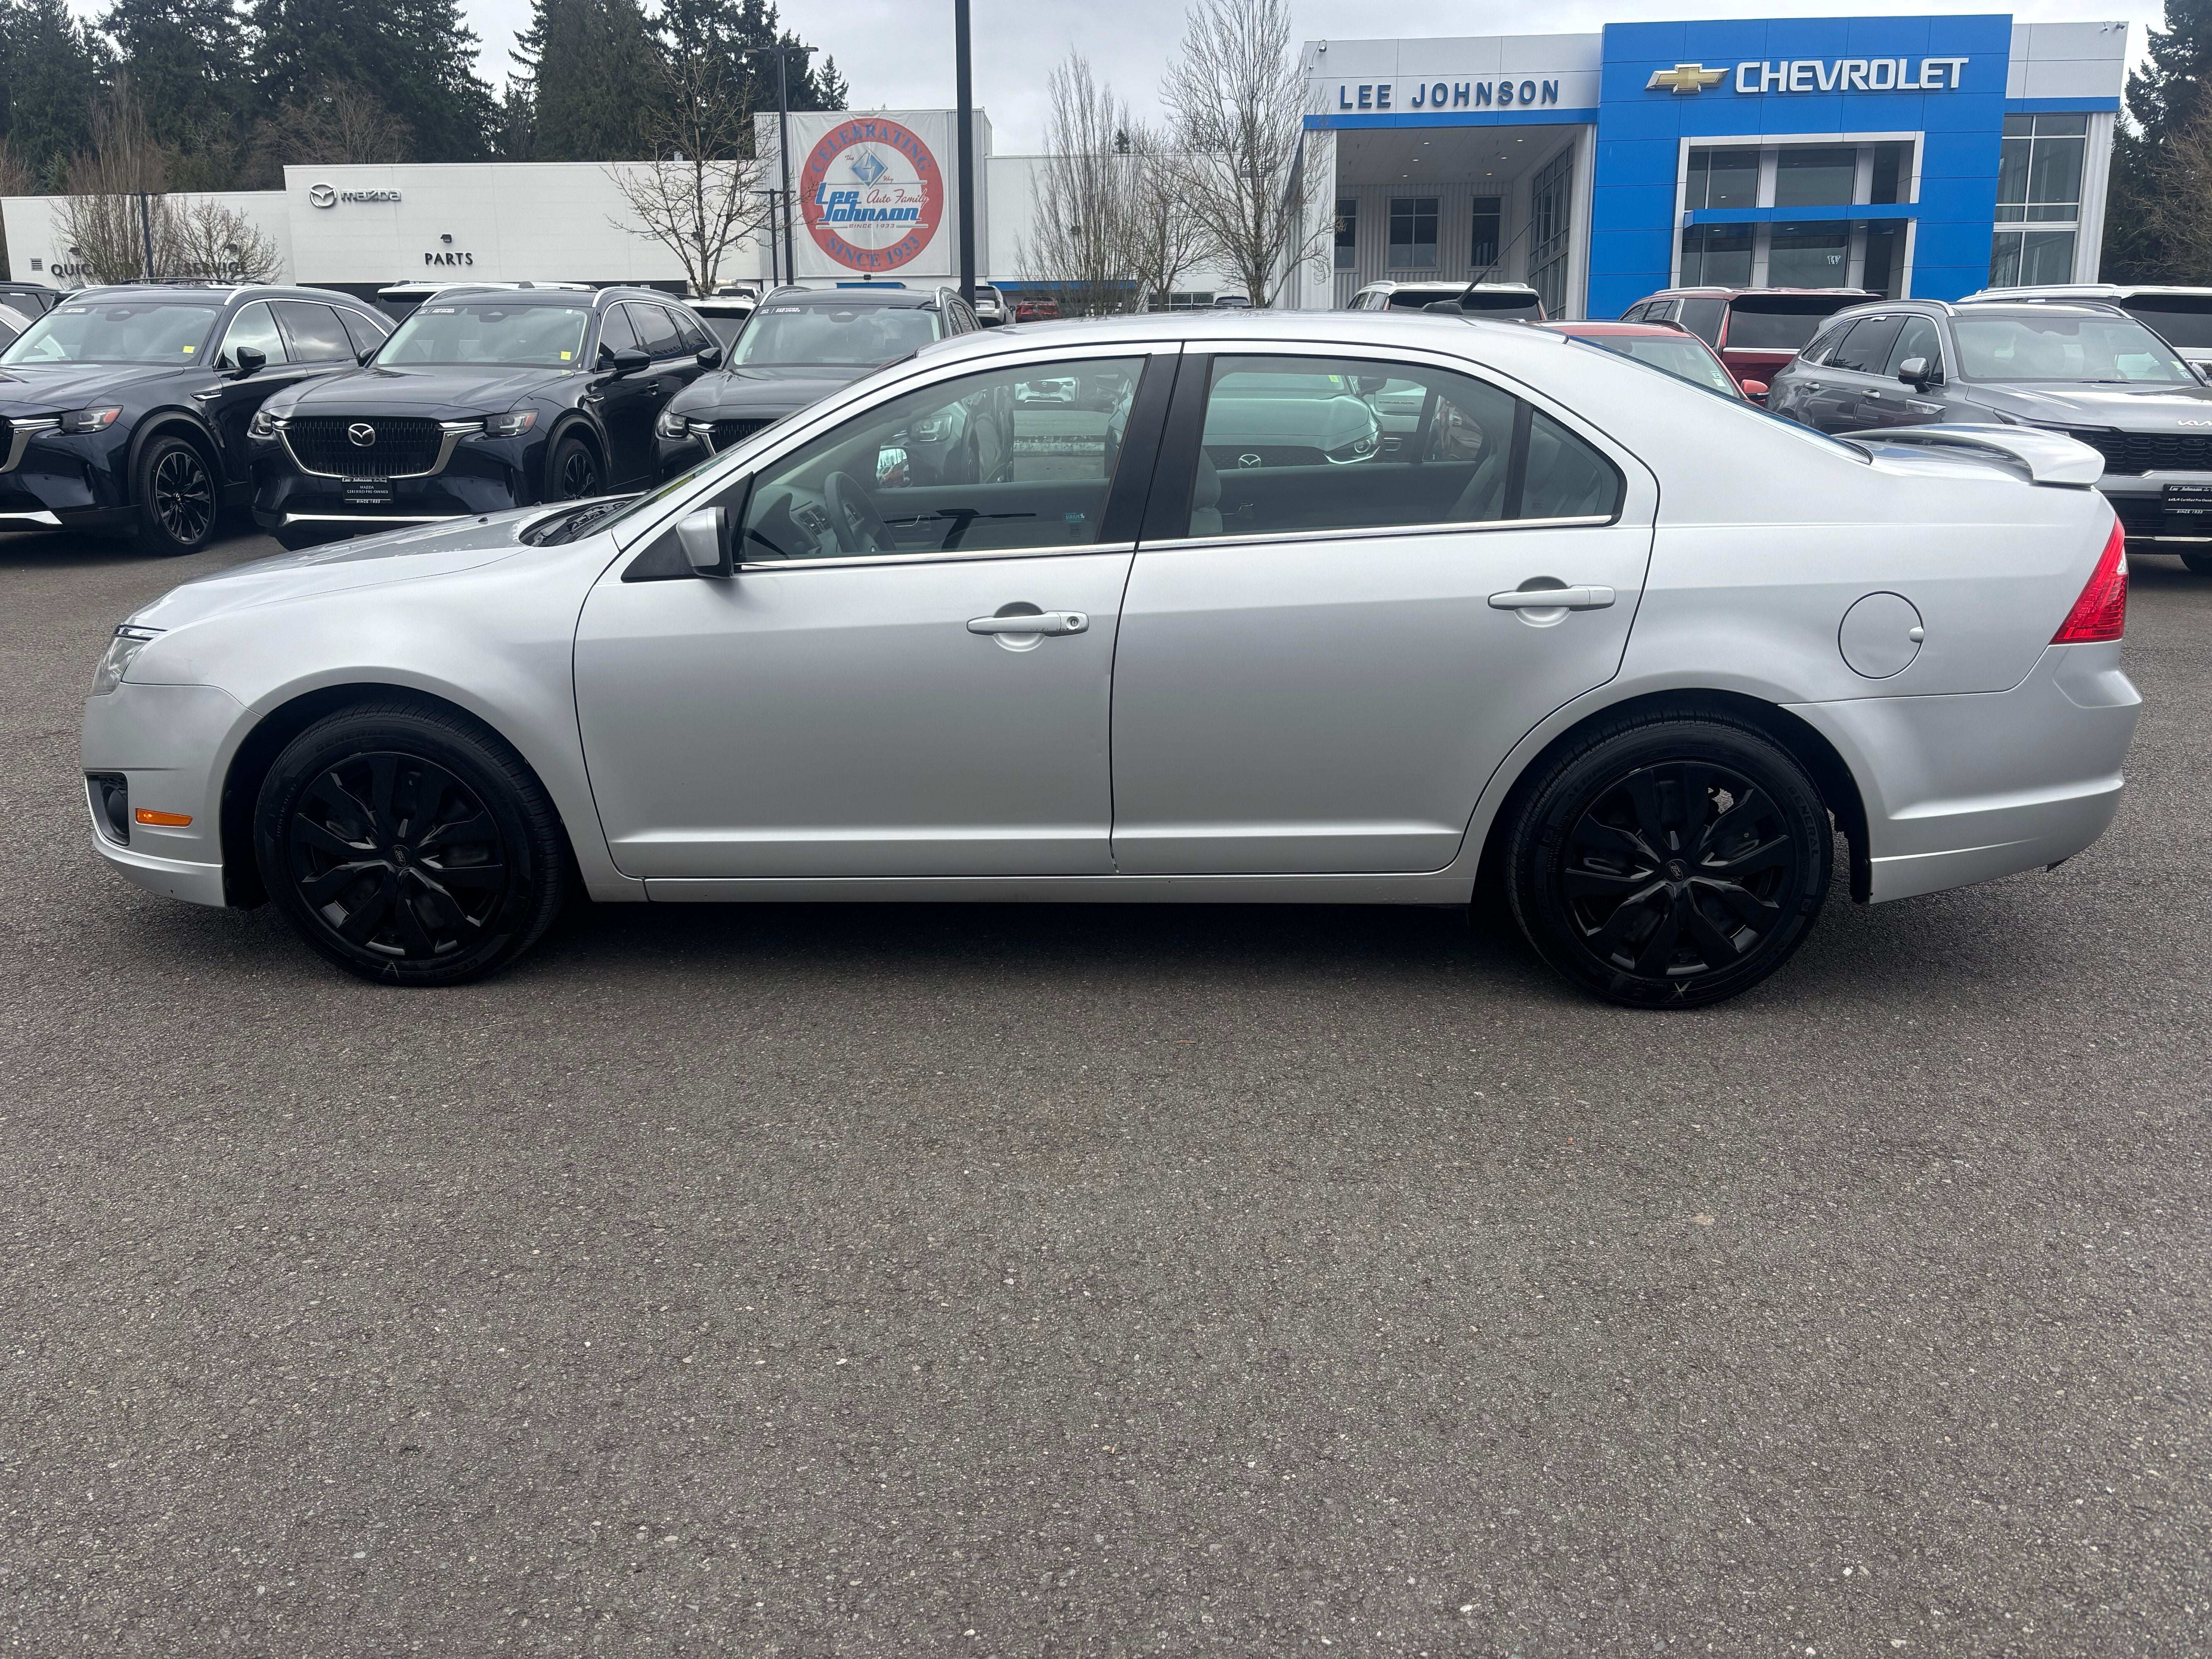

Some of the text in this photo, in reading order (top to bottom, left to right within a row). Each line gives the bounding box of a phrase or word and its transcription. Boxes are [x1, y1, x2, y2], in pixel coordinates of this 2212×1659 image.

[1735, 57, 1969, 93] CHEVROLET
[1340, 80, 1559, 108] LEE JOHNSON
[811, 124, 931, 172] CELEBRATING
[815, 182, 861, 204] Lee
[867, 189, 929, 210] Auto Family
[818, 200, 922, 222] Johnson
[425, 253, 473, 265] PARTS
[826, 235, 920, 267] SINCE 1933
[51, 263, 101, 278] QUIC
[1787, 785, 1819, 859] GENERAL
[1671, 865, 1681, 876] Ford
